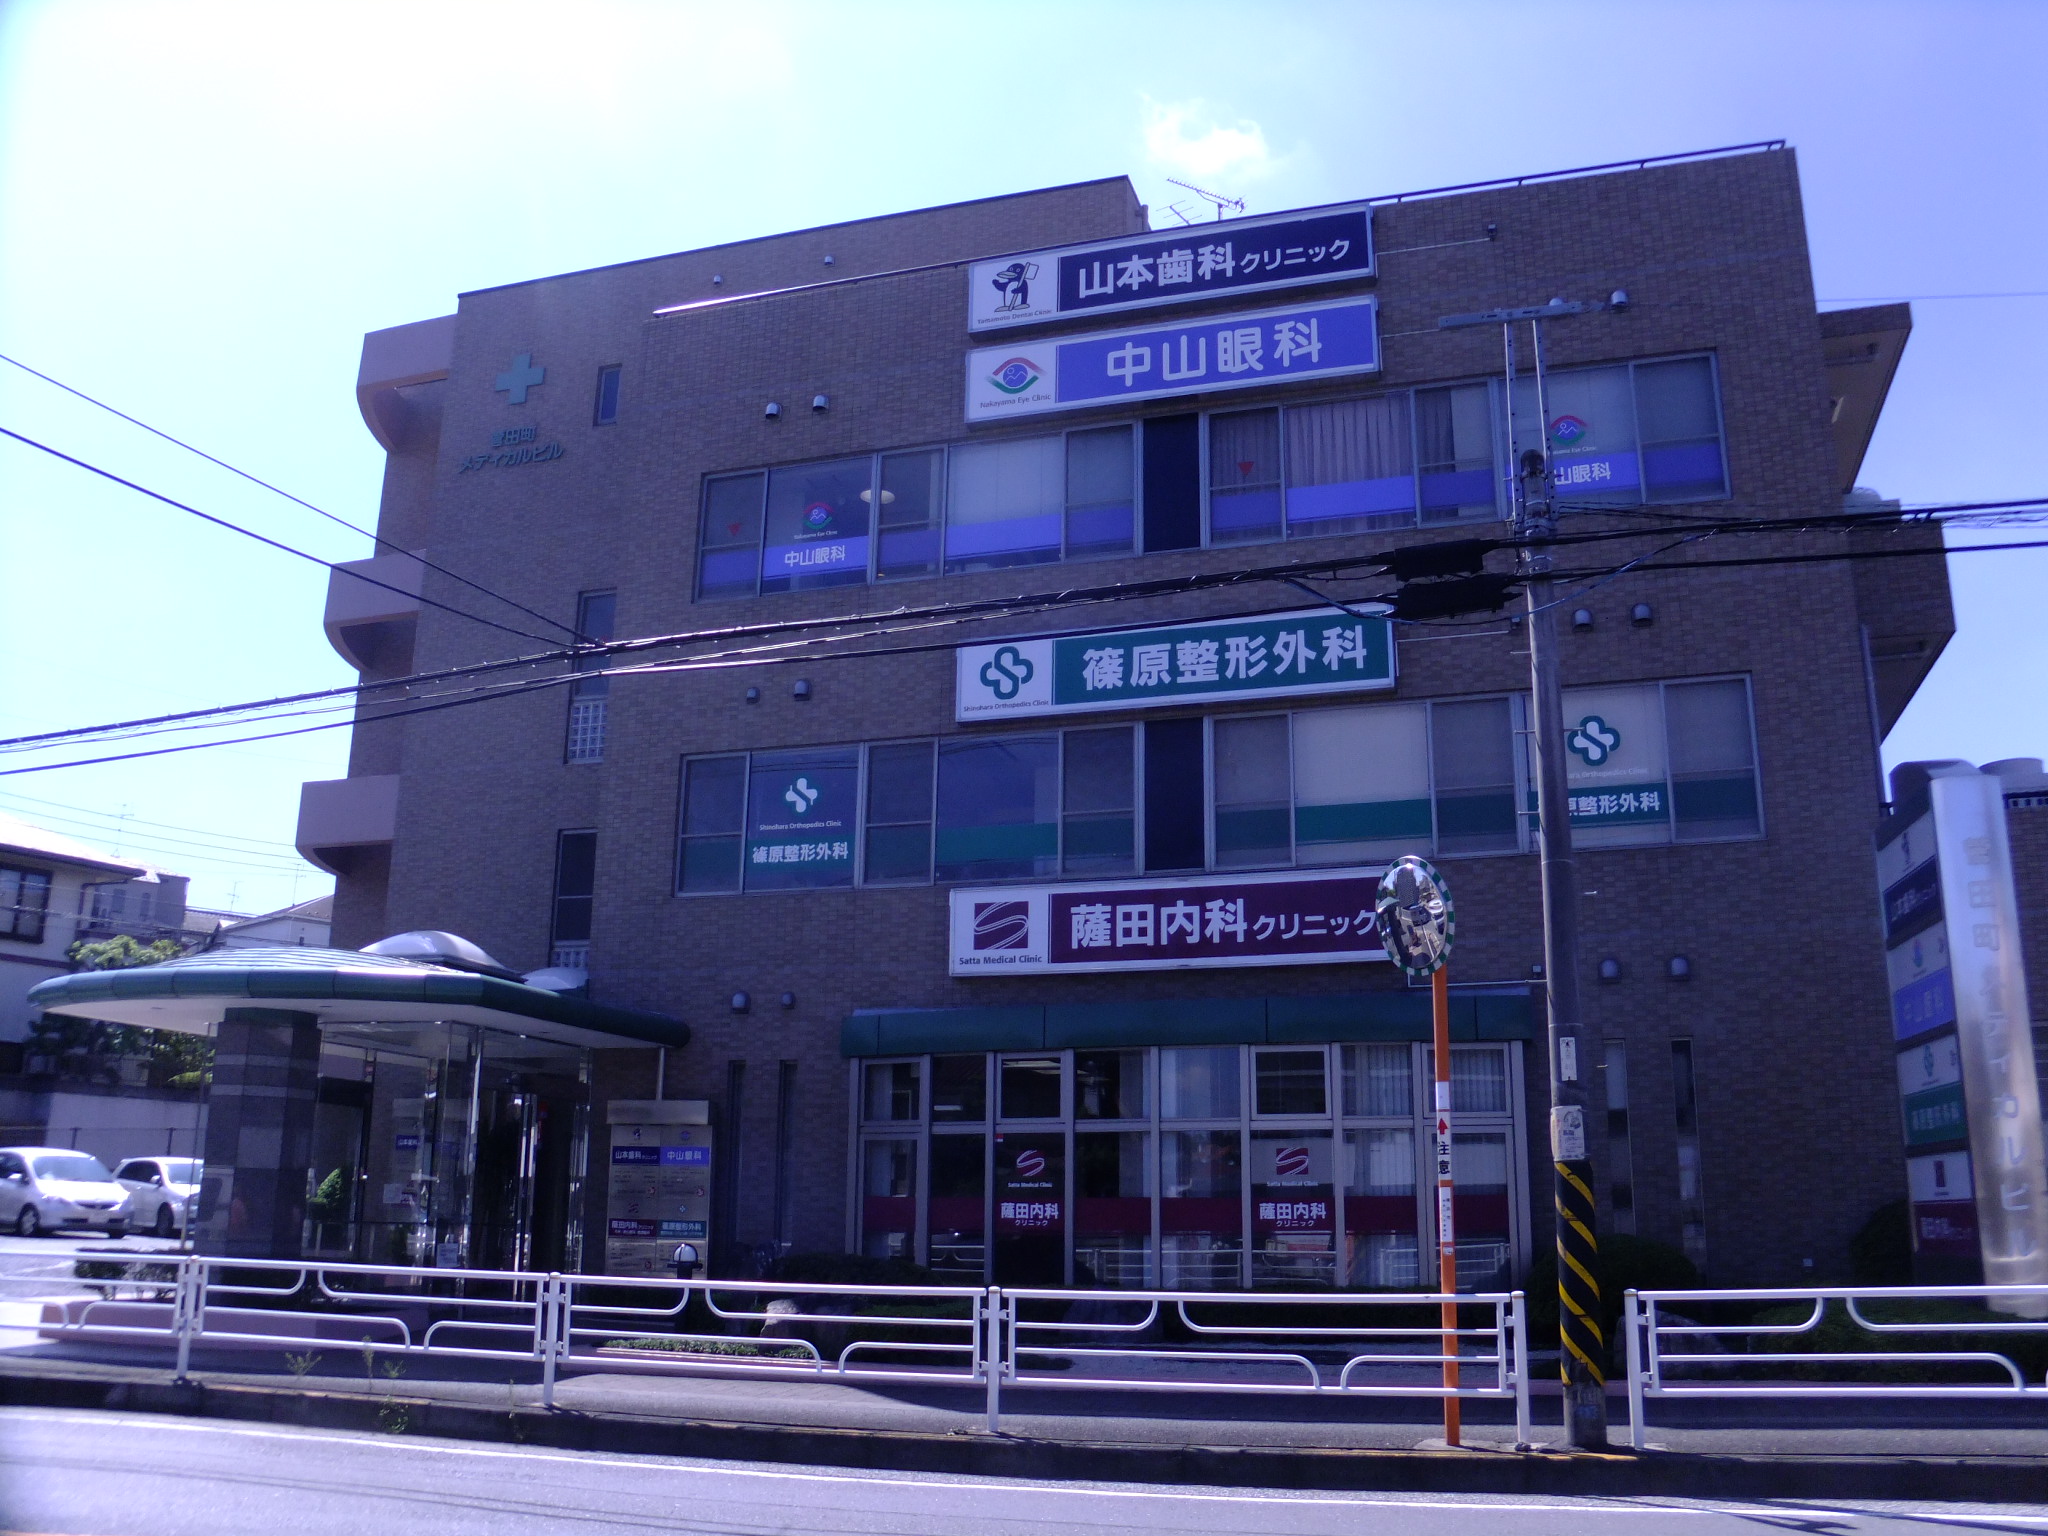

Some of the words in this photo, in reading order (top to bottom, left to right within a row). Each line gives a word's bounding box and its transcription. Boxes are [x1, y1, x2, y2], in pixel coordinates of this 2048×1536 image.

[1078, 239, 1350, 298] 山本歯科クリニック
[1107, 317, 1322, 387] 中山眼科
[980, 399, 1016, 408] Nakayama
[1017, 396, 1030, 404] Eye
[1032, 394, 1051, 402] Clinic
[459, 443, 565, 474] メディカルビル
[1553, 462, 1611, 485] 山眼科
[784, 545, 846, 567] 中山眼科
[1082, 624, 1367, 690] 篠原整形外科
[994, 701, 1031, 710] Orthopedics
[826, 819, 842, 827] Clinic
[752, 841, 848, 864] 篠原整形外科
[1071, 898, 1377, 949] 薩田内科クリニック
[959, 957, 981, 965] Satta
[983, 955, 1016, 964] Medical
[1018, 954, 1042, 963] Clinic
[1438, 1141, 1450, 1175] 注意
[1000, 1202, 1059, 1219] 薩田内科
[1259, 1202, 1327, 1219] 薩田内科
